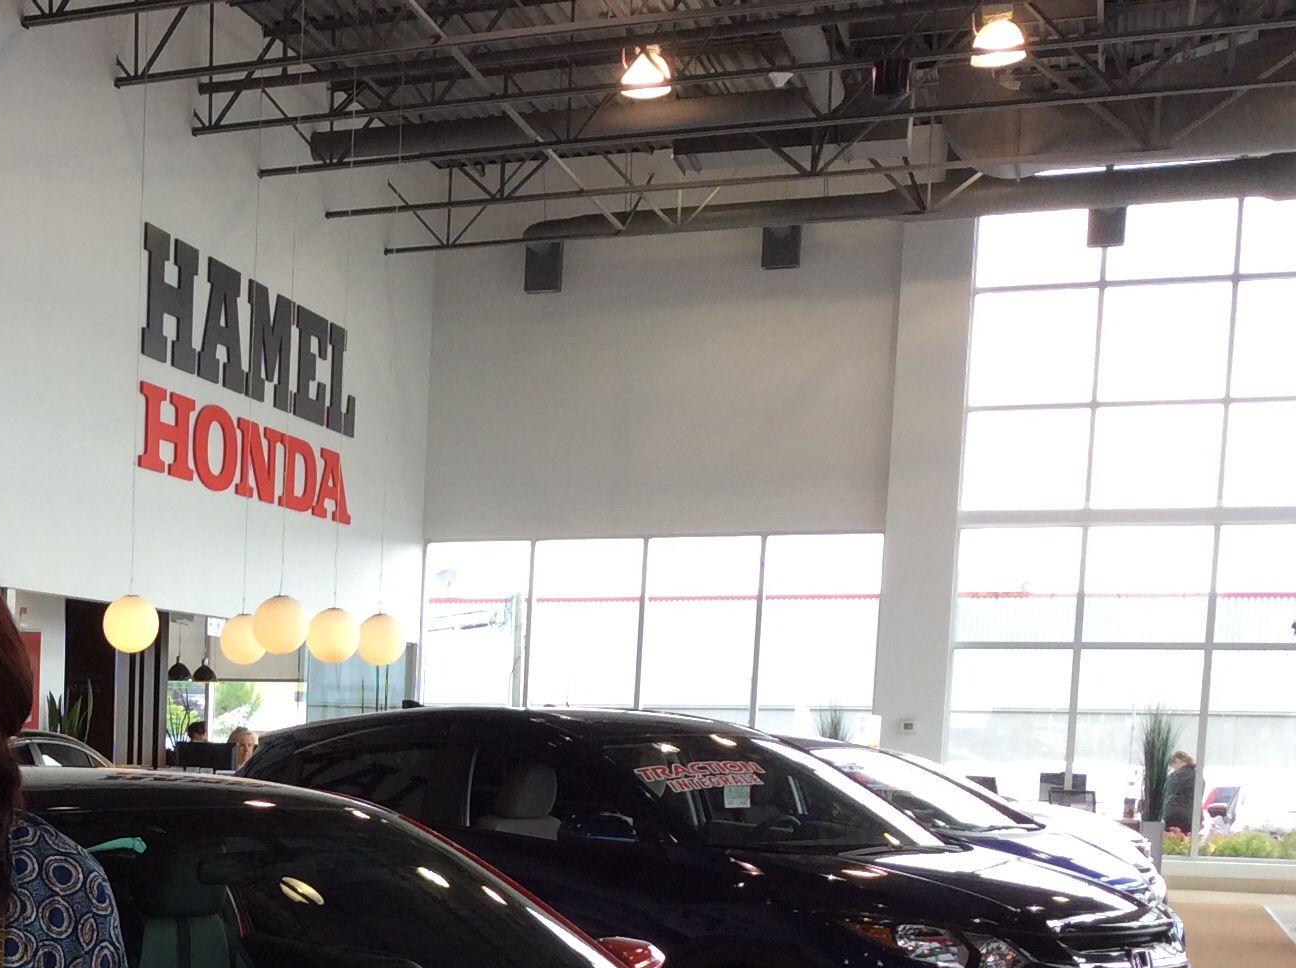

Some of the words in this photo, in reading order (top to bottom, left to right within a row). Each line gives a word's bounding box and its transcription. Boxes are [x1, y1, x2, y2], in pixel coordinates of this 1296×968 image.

[141, 221, 356, 438] HAMEL
[137, 380, 351, 525] HONDA
[633, 760, 766, 783] TRACTION
